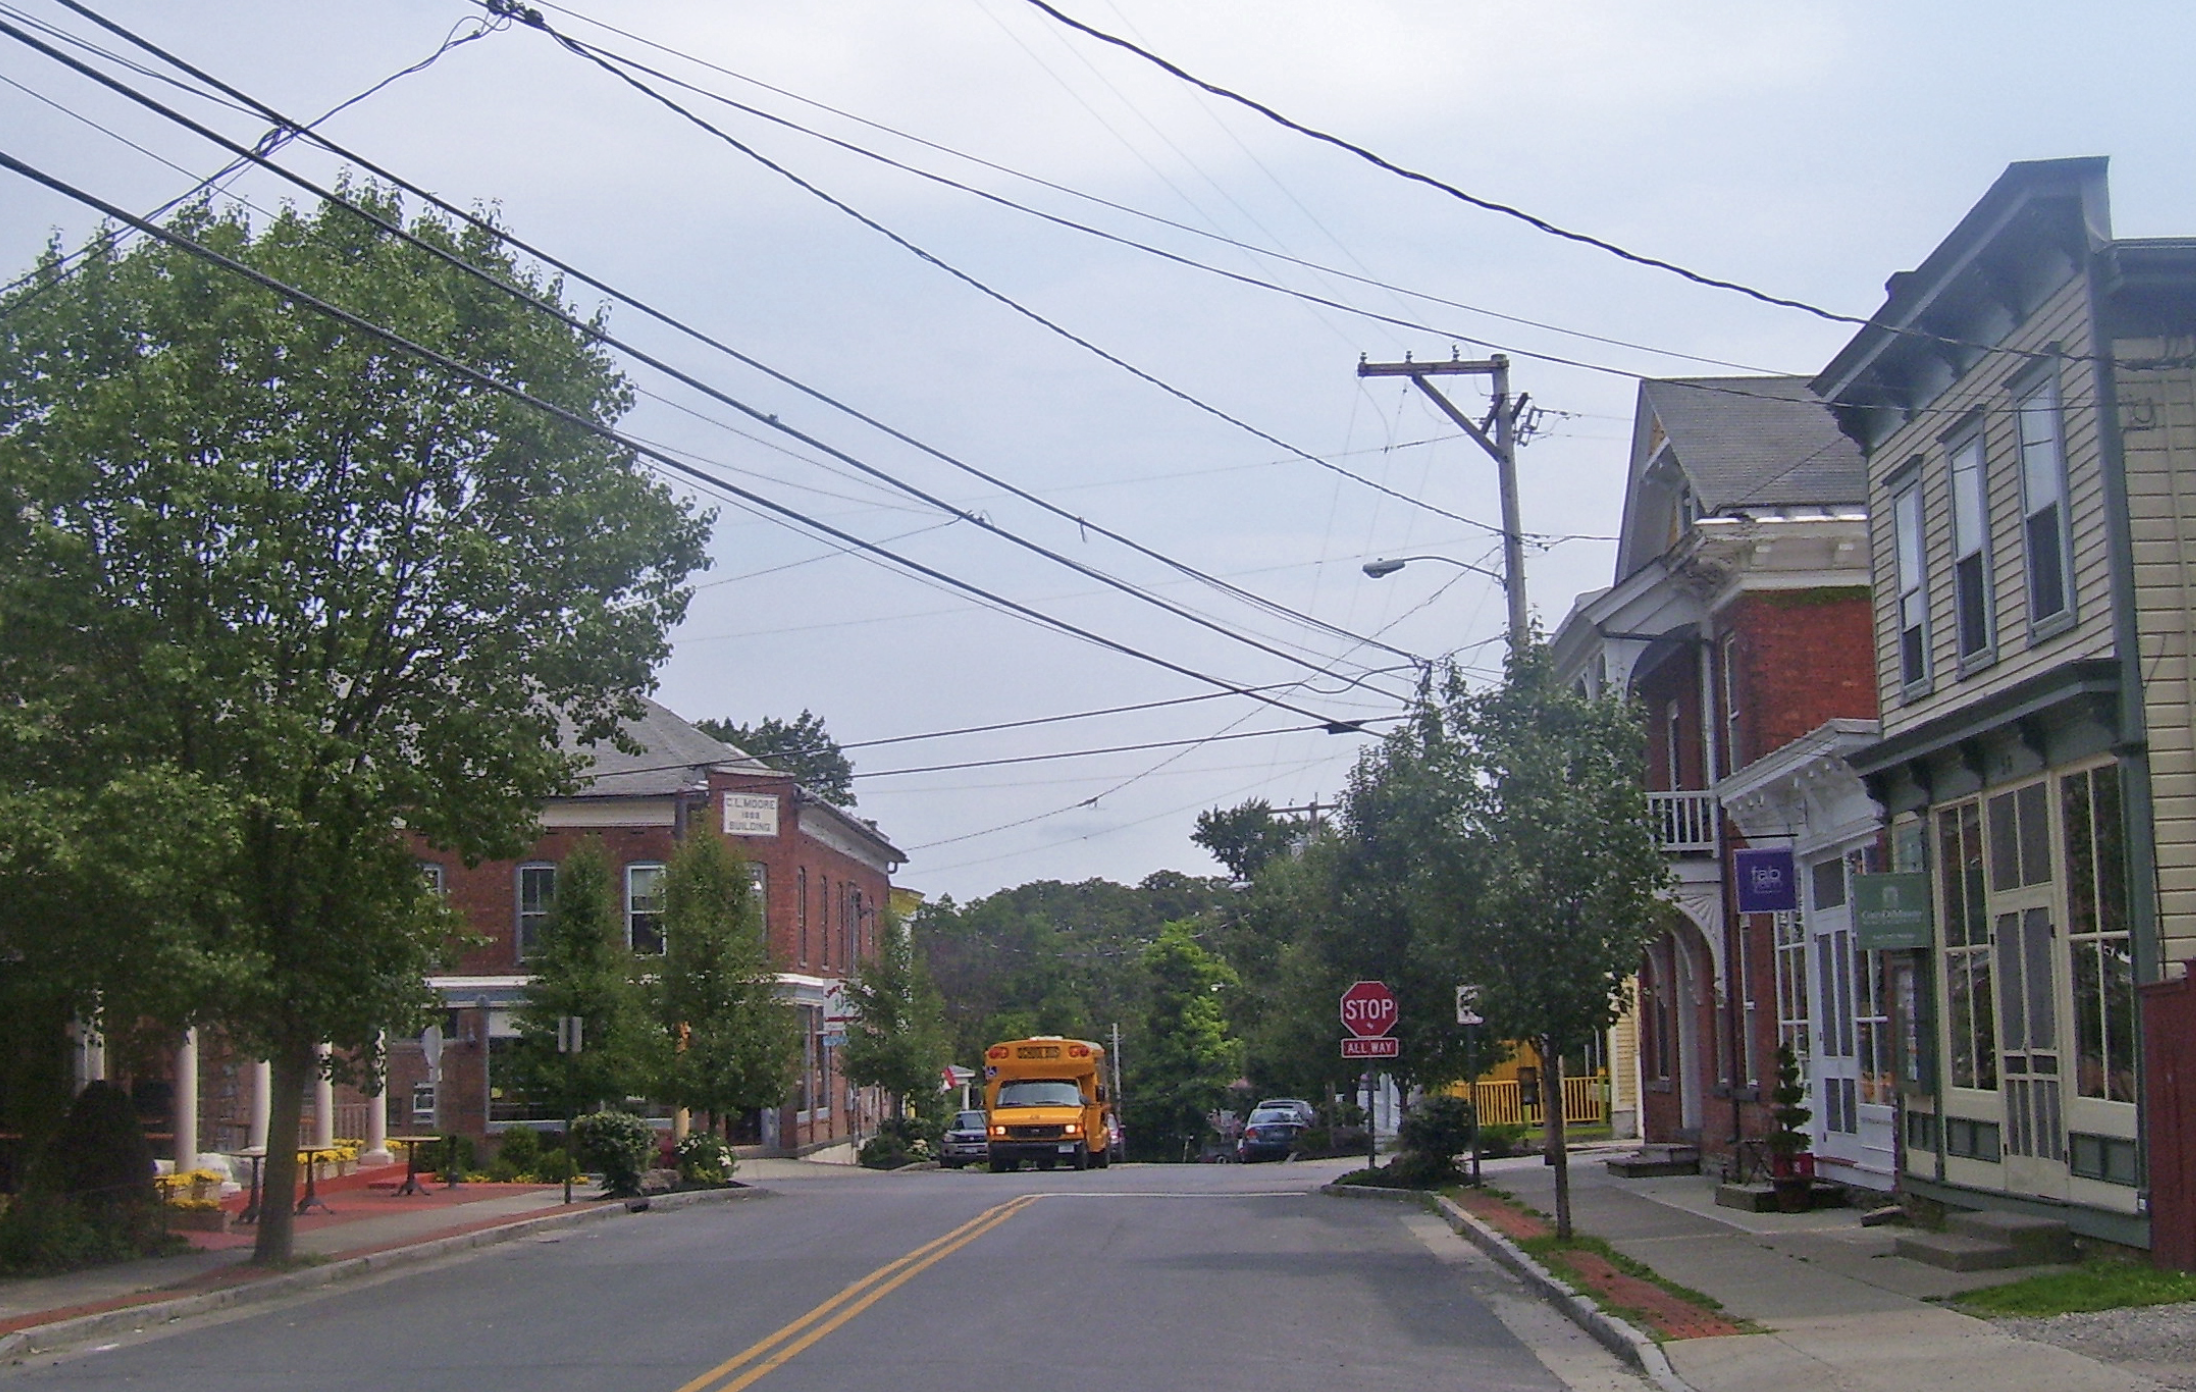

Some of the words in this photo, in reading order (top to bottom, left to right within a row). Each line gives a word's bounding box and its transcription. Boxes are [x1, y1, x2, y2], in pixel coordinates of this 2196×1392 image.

[729, 821, 771, 832] BUILDING
[1751, 865, 1781, 882] fab
[1345, 998, 1394, 1020] STOP
[1347, 1042, 1367, 1054] ALL
[1370, 1041, 1393, 1053] WAY
